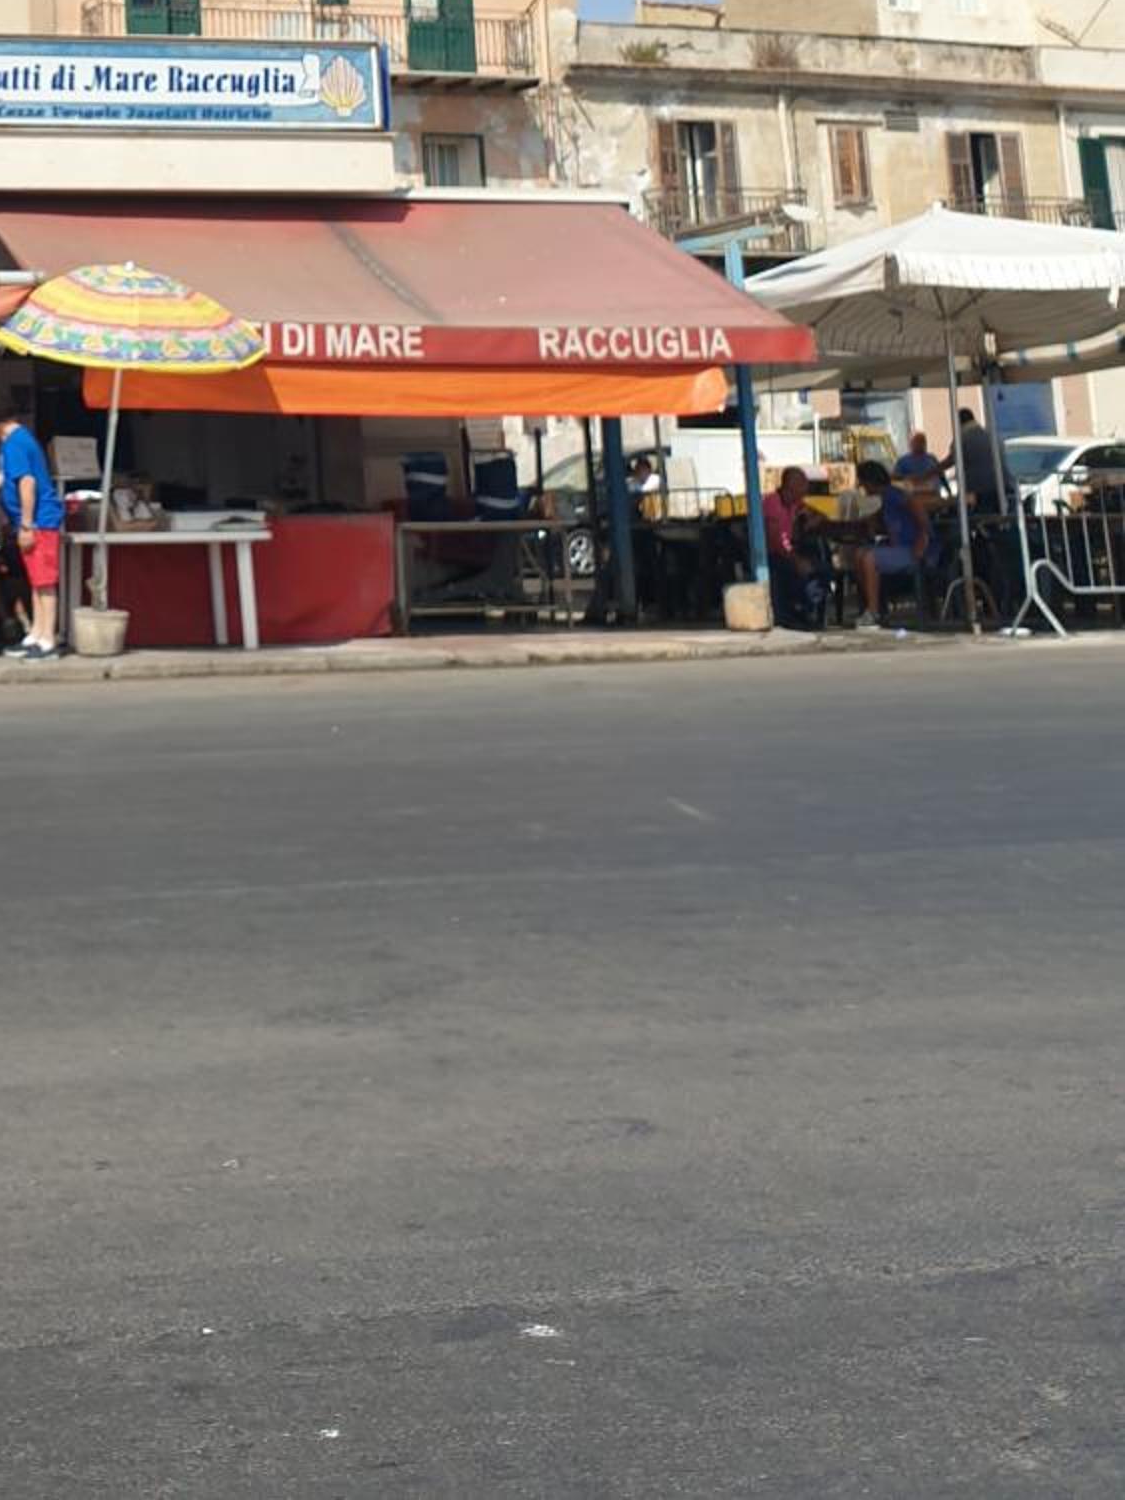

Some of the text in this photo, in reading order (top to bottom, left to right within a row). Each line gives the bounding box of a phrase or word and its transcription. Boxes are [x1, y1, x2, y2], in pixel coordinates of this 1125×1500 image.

[50, 64, 76, 91] di
[84, 65, 158, 92] Mare
[168, 65, 296, 98] Raccuglia
[282, 321, 316, 357] DI
[325, 322, 425, 358] MARE
[538, 325, 733, 360] RACCUGLIA
